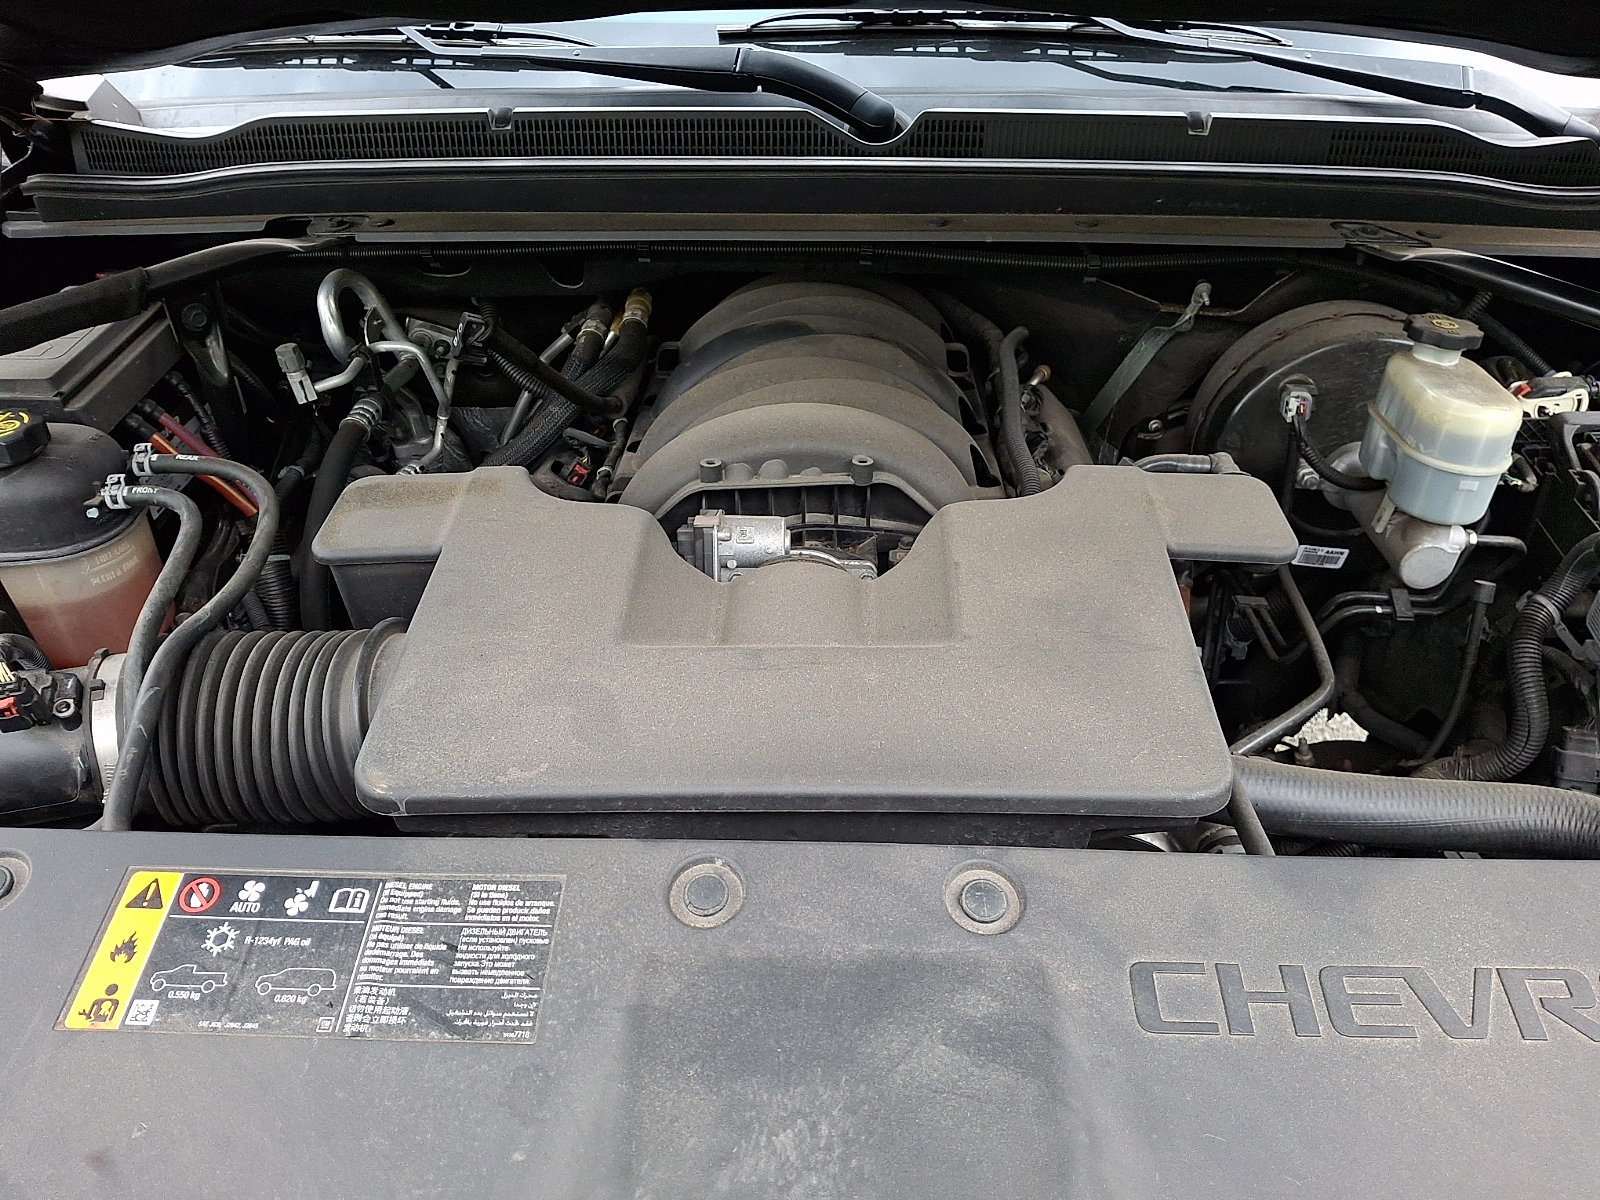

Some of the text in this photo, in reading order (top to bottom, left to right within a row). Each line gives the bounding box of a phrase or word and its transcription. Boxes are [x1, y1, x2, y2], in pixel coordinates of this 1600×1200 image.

[131, 486, 160, 494] FRONT
[384, 881, 433, 890] DIESEL ENGINE
[497, 884, 520, 892] DIESEL
[228, 901, 261, 914] AUTO
[371, 925, 424, 934] MOTEUR DIESEL
[460, 927, 548, 936] ДИЗЕЛЬНЫЙ ДВИГАТЕЛЬ
[244, 935, 311, 947] R-1234yf PAG oil
[410, 950, 424, 958] Des
[168, 990, 201, 1001] 0.550 kg
[274, 994, 307, 1005] 0.820 kg
[1129, 961, 1600, 1043] CHEVR
